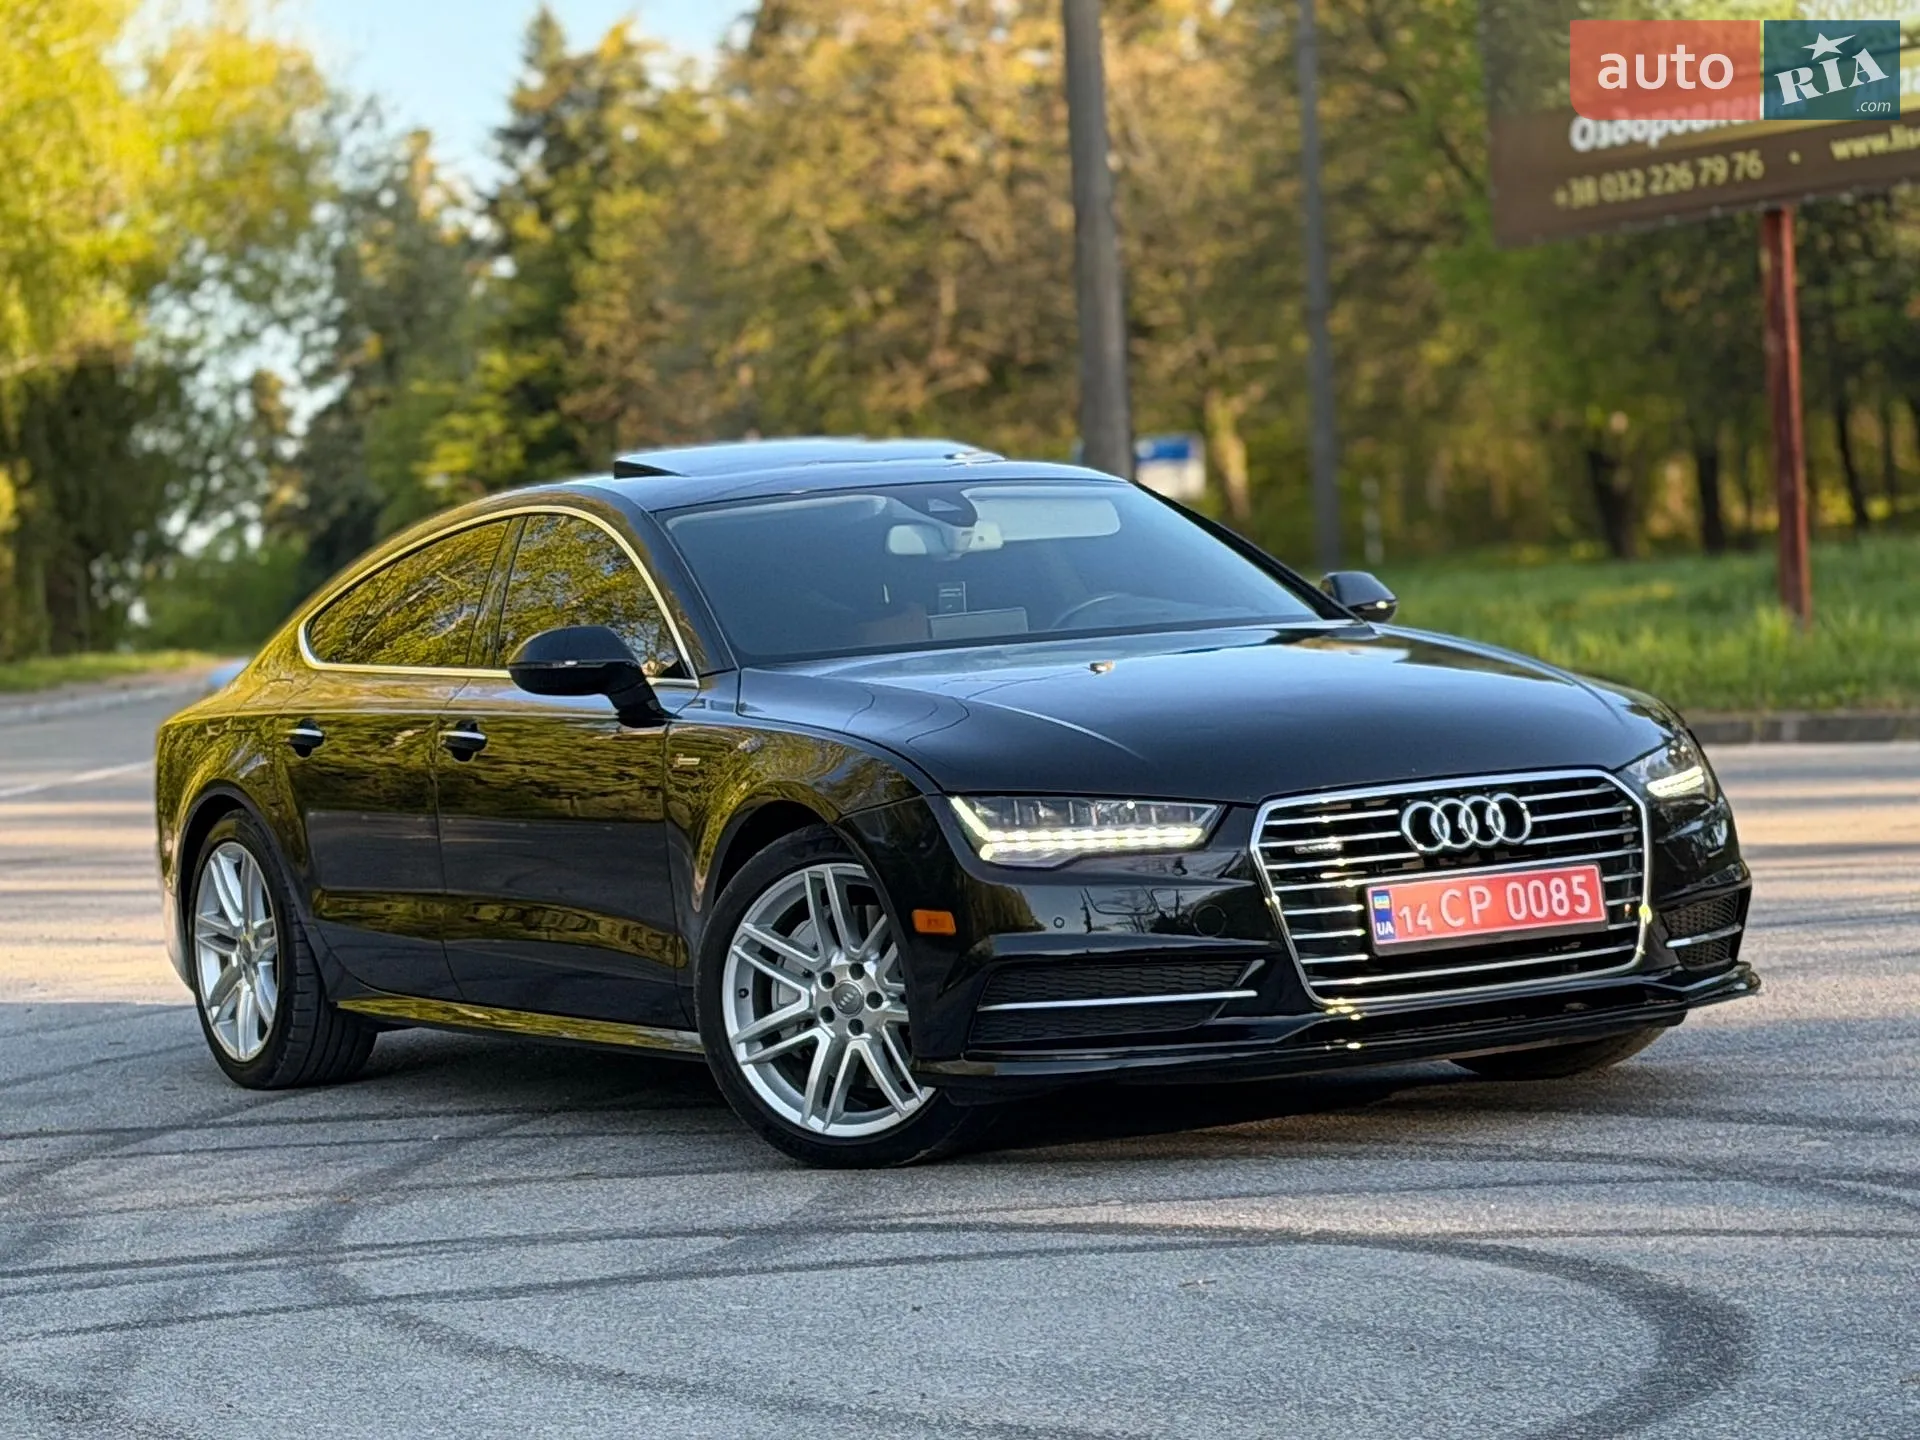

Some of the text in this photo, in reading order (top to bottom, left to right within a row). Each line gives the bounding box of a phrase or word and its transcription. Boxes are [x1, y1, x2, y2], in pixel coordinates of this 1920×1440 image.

[1602, 168, 1646, 203] 032
[1647, 158, 1695, 196] 226
[1696, 154, 1728, 187] 79
[1731, 148, 1764, 182] 76
[1376, 921, 1395, 935] UA
[1398, 875, 1591, 933] 14 CP 0085
